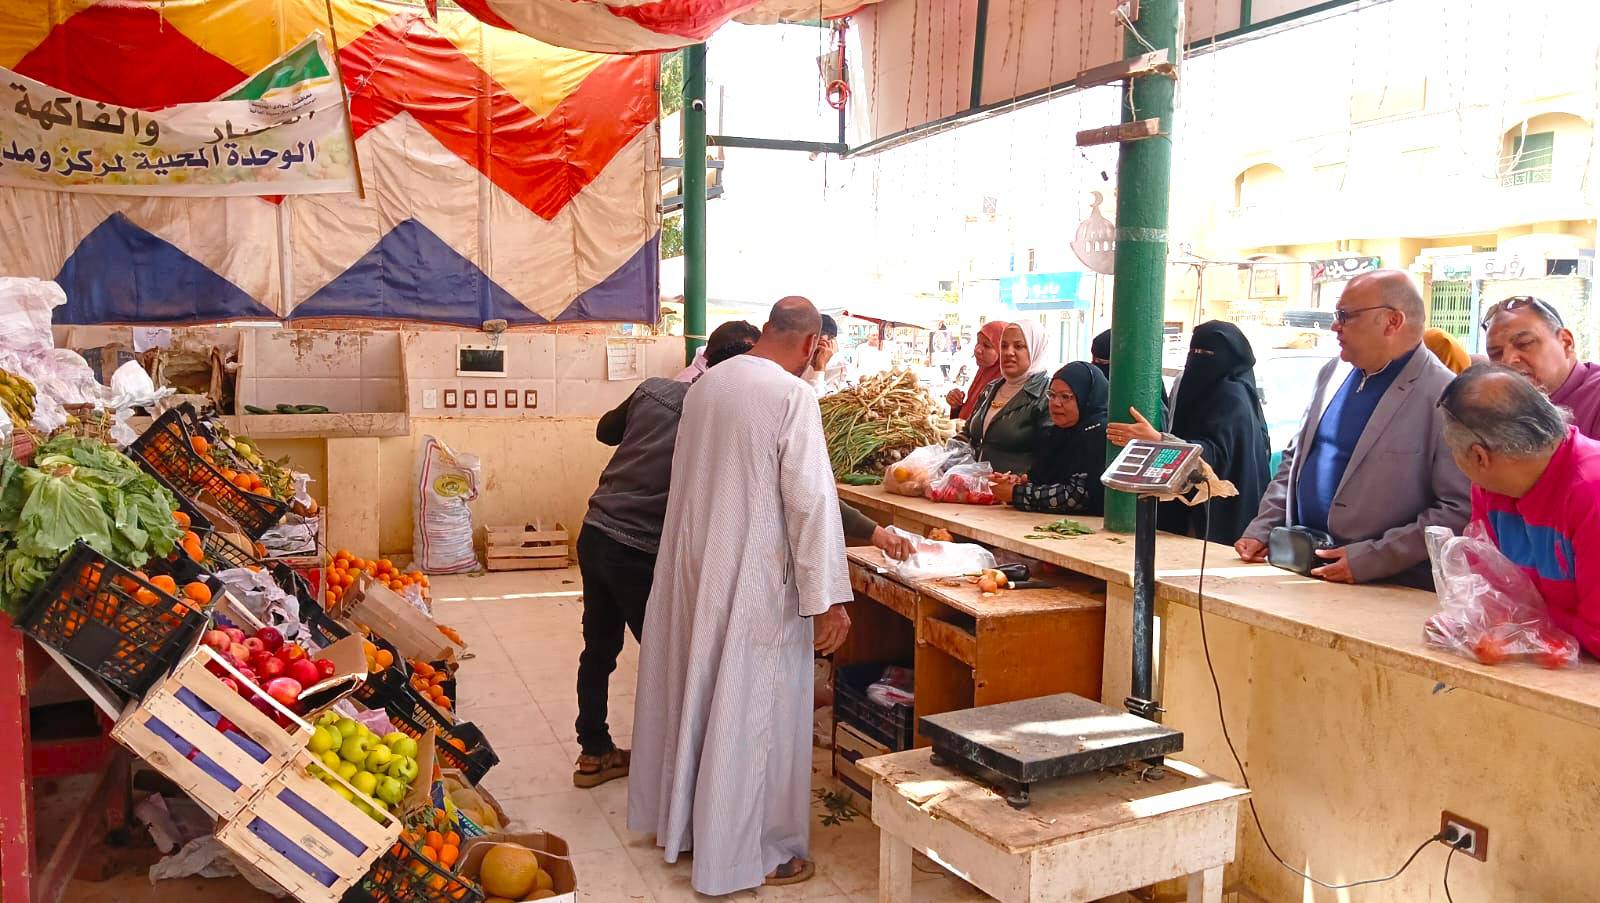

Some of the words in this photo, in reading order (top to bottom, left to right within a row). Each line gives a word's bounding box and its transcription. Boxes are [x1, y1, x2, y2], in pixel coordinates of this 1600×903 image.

[9, 82, 160, 147] والفاكهة
[0, 139, 52, 173] ومد
[57, 147, 127, 177] لمركز
[224, 140, 316, 170] الوحدة
